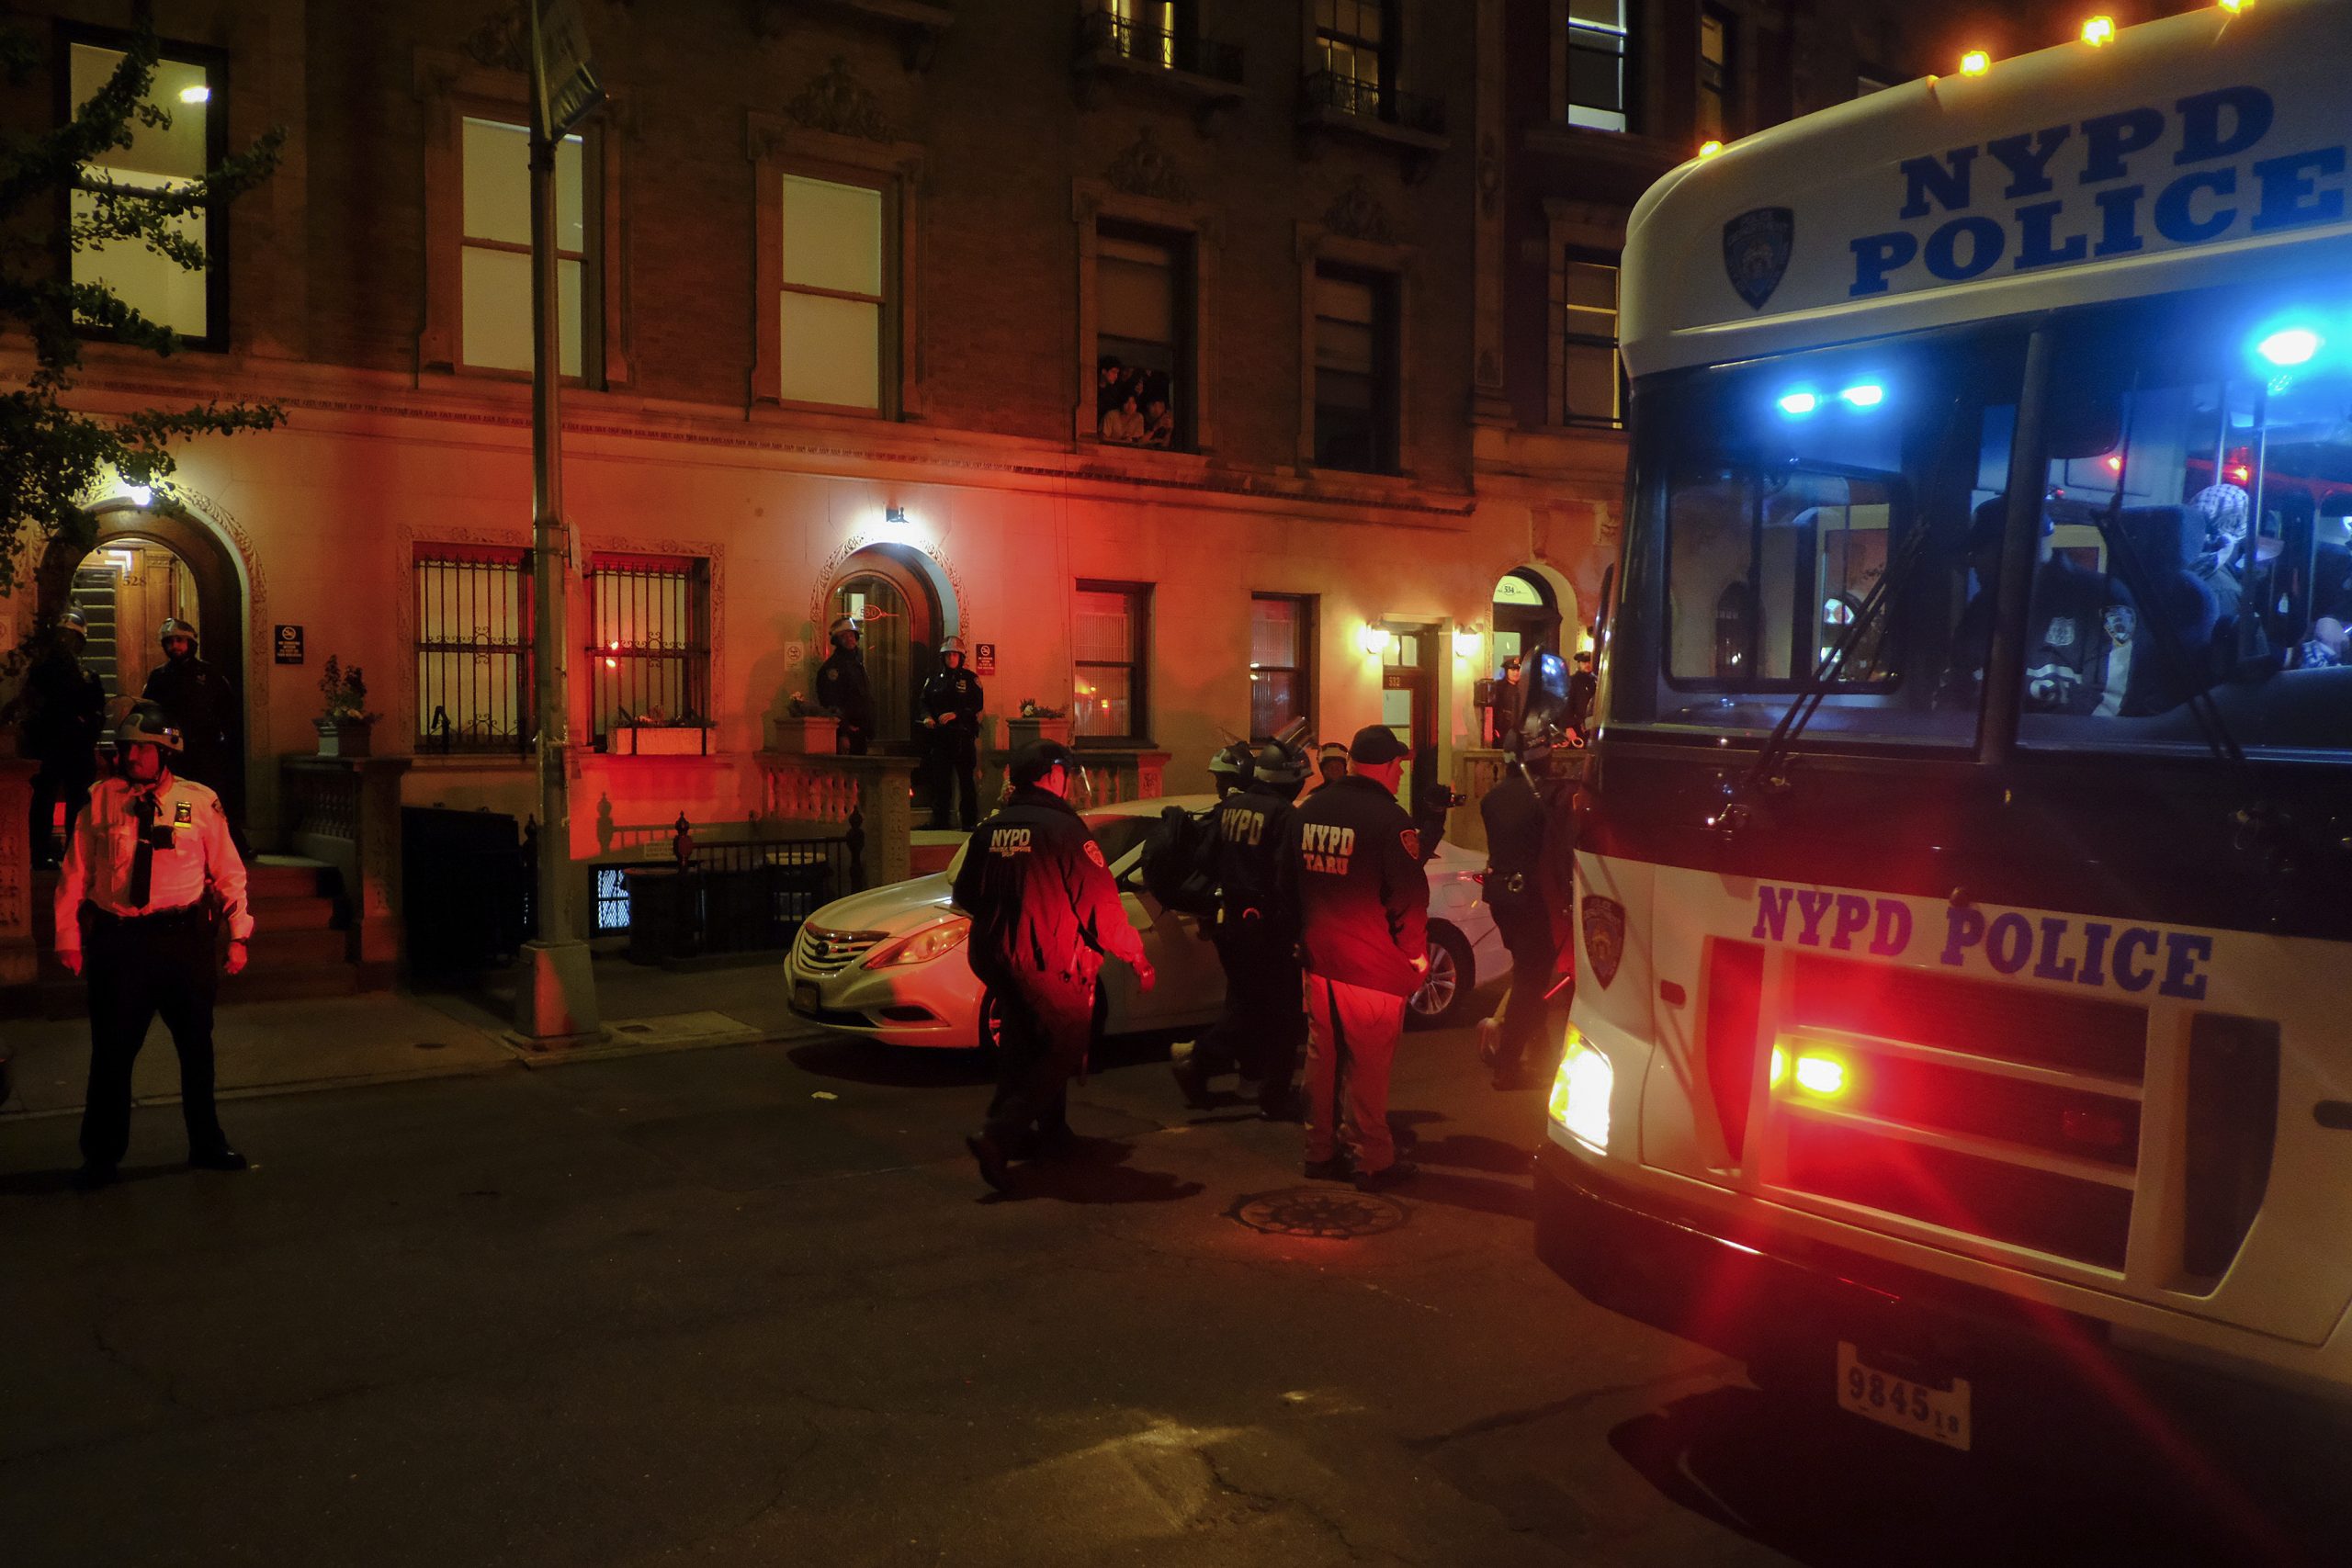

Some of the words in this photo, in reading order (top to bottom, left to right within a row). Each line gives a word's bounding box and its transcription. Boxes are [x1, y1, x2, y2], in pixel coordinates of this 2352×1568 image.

[1900, 85, 2274, 220] NYPD
[1849, 145, 2346, 297] POLICE
[122, 576, 147, 587] 528
[991, 829, 1031, 847] NYPD
[1220, 808, 1265, 846] NYPD
[1301, 823, 1356, 856] NYPD
[1303, 852, 1350, 875] TARU
[1752, 886, 1912, 956] NYPD
[1940, 906, 2212, 1000] POLICE
[1849, 1366, 1929, 1422] 9845
